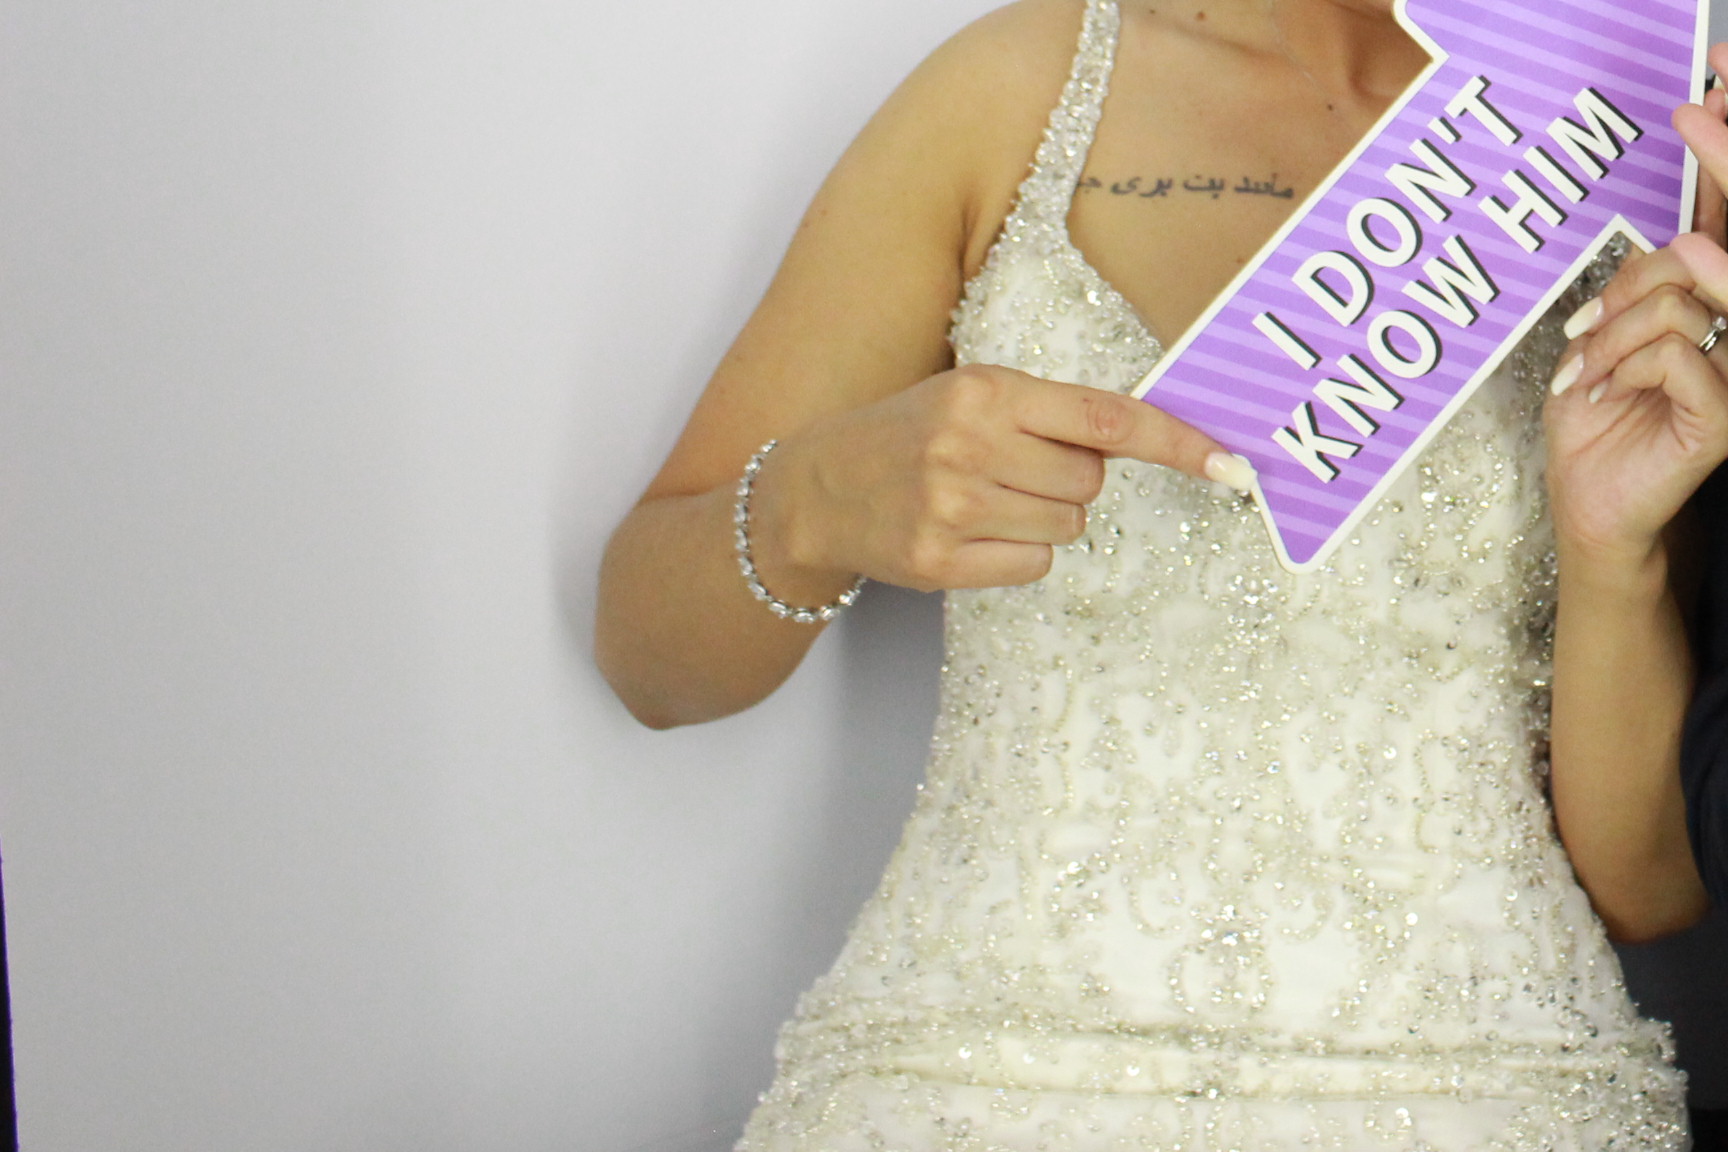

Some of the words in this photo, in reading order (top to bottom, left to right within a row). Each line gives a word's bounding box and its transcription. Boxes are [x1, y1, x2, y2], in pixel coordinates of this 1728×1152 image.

[1252, 311, 1321, 371] I
[1291, 75, 1525, 329] DON'T
[1271, 235, 1501, 485] KNOW
[1477, 87, 1644, 254] HIM
